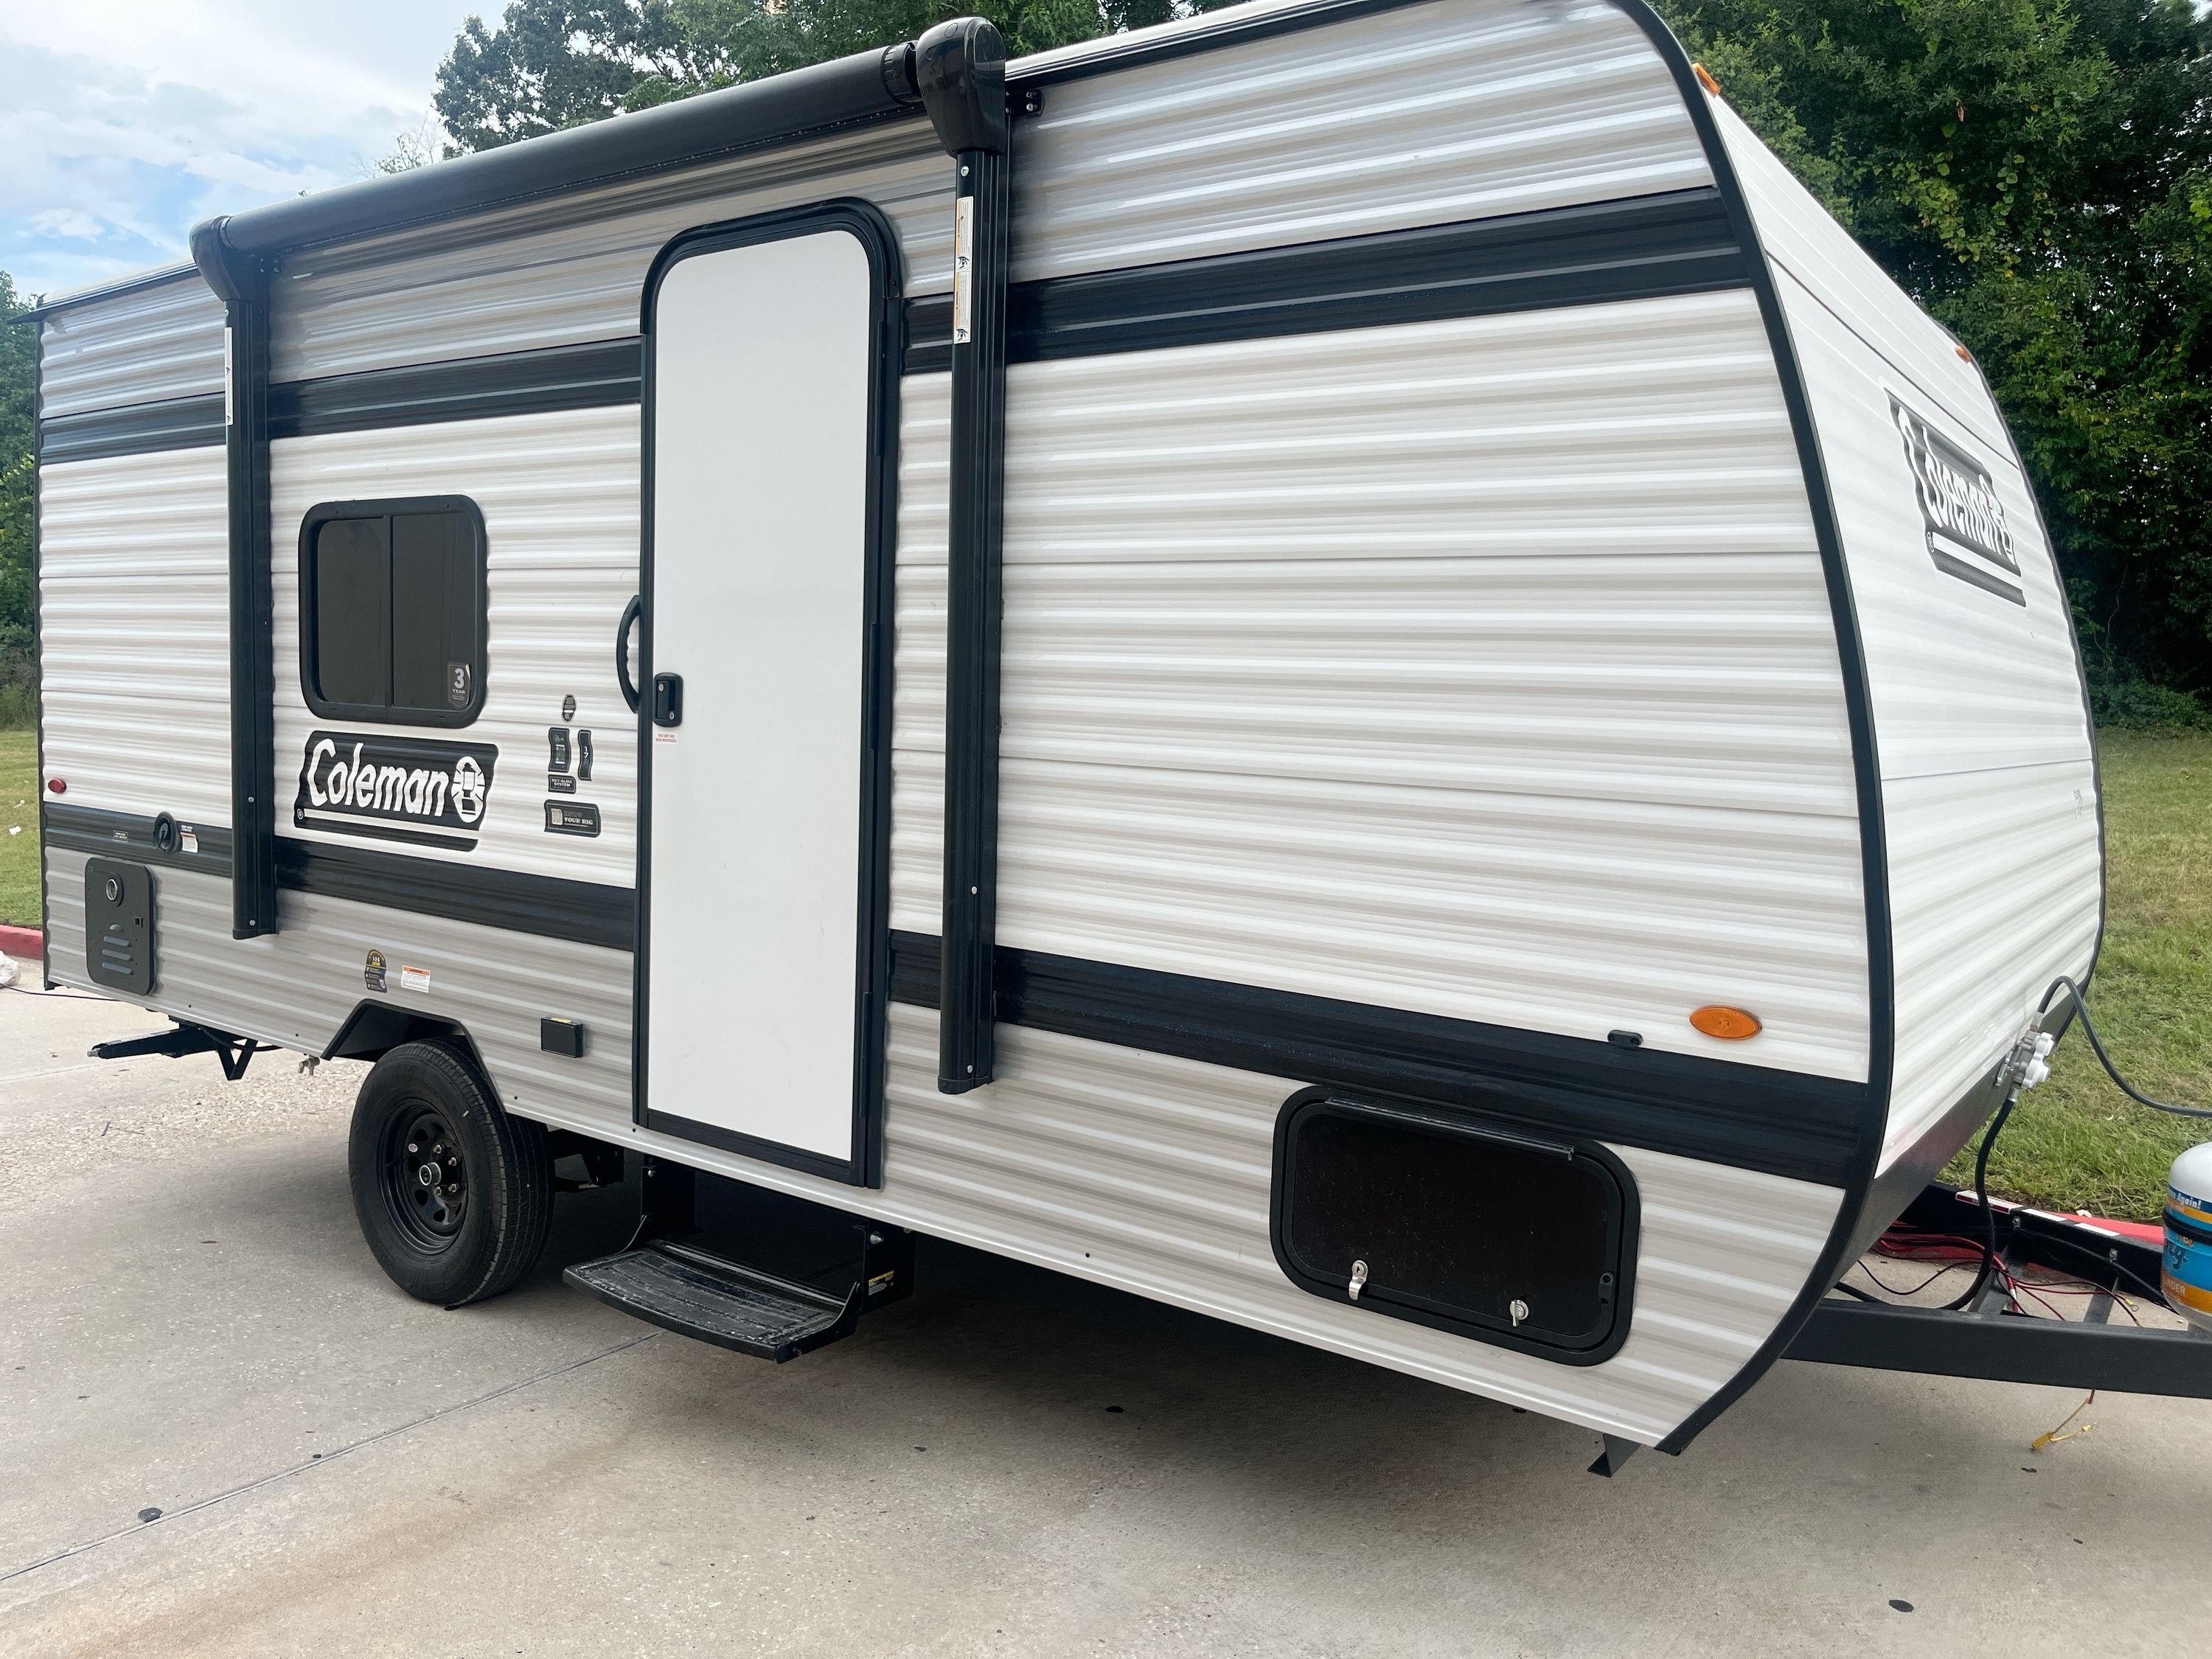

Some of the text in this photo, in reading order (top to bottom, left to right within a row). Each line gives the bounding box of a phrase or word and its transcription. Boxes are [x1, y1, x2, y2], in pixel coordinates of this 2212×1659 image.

[1897, 406, 2002, 555] Coleman
[454, 667, 465, 689] 3
[307, 738, 449, 817] Coleman
[2177, 1192, 2202, 1209] Again!
